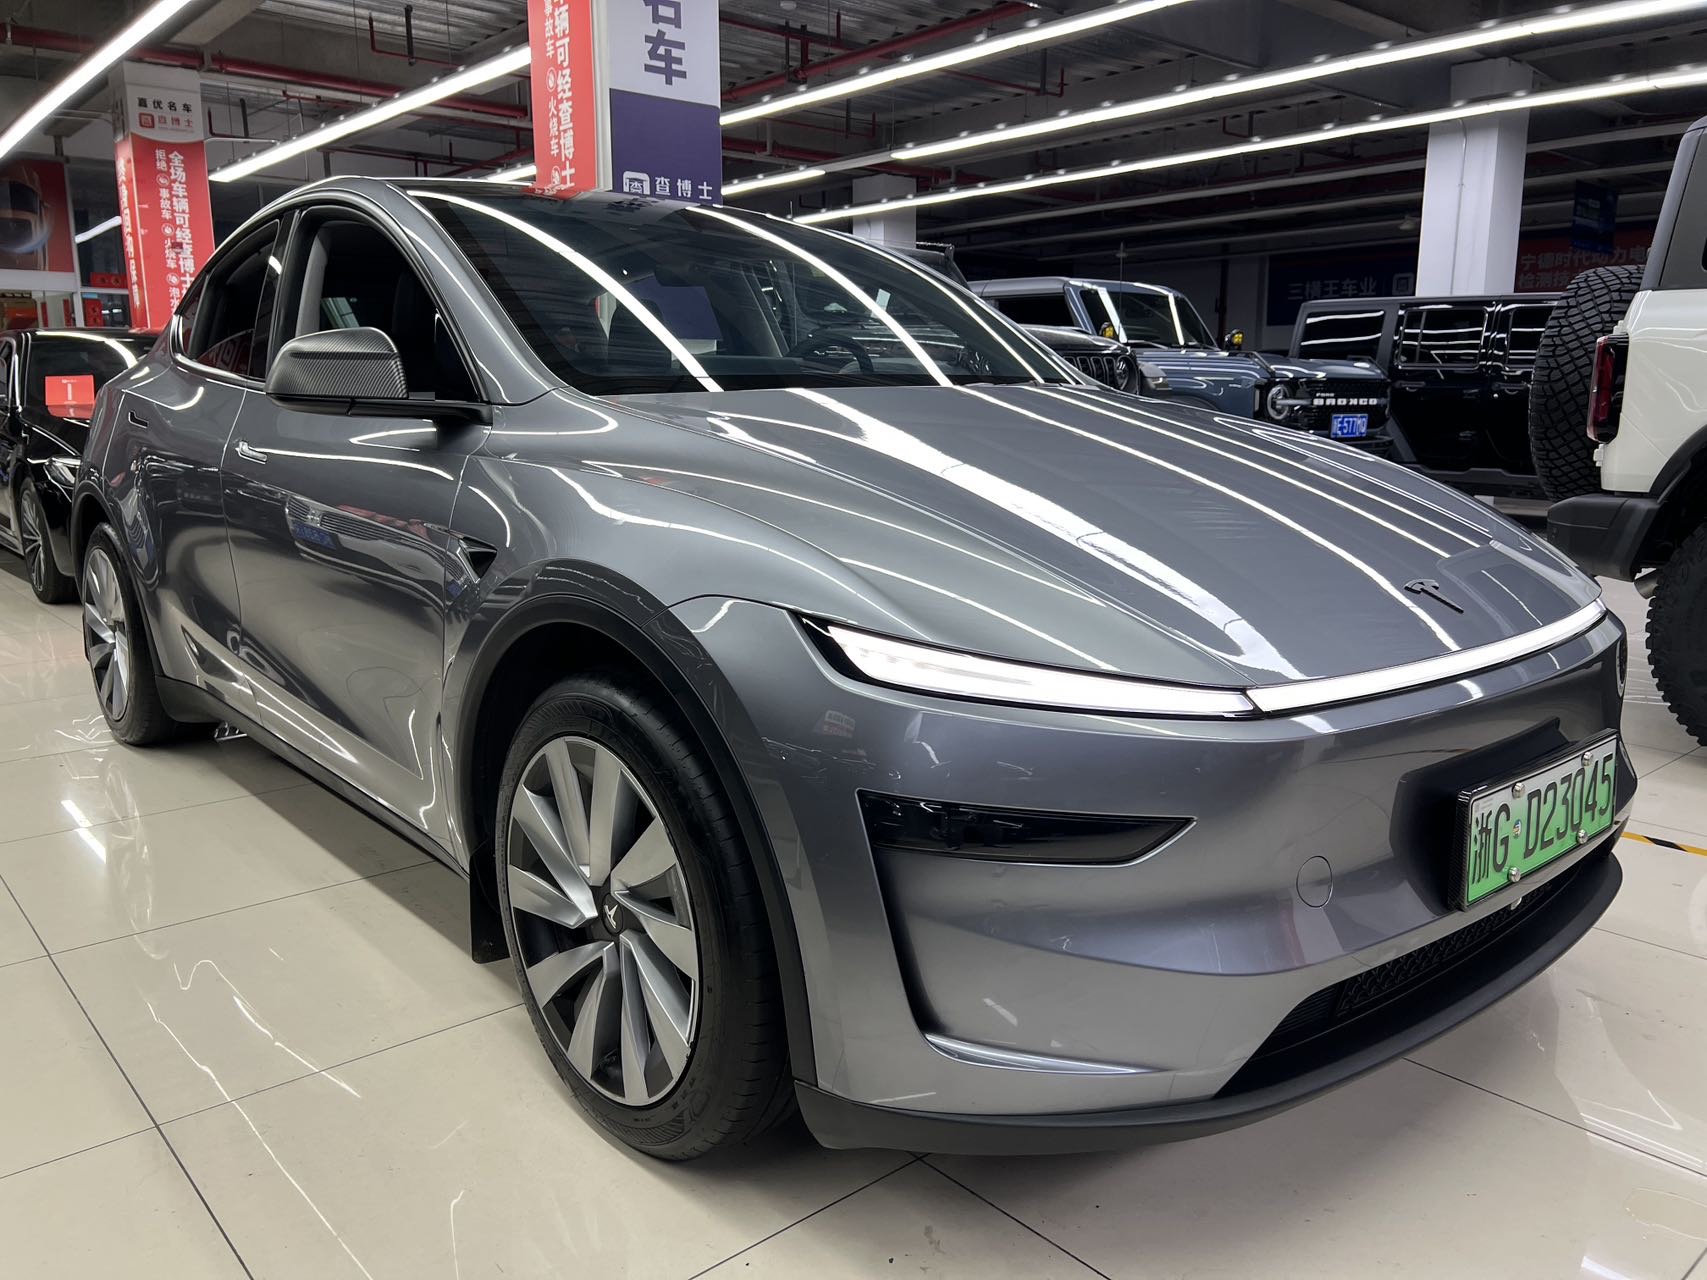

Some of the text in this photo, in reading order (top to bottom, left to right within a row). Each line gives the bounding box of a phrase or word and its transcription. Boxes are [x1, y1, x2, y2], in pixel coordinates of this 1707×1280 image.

[553, 0, 576, 187] 辆可经查博士
[654, 176, 713, 200] 查博士
